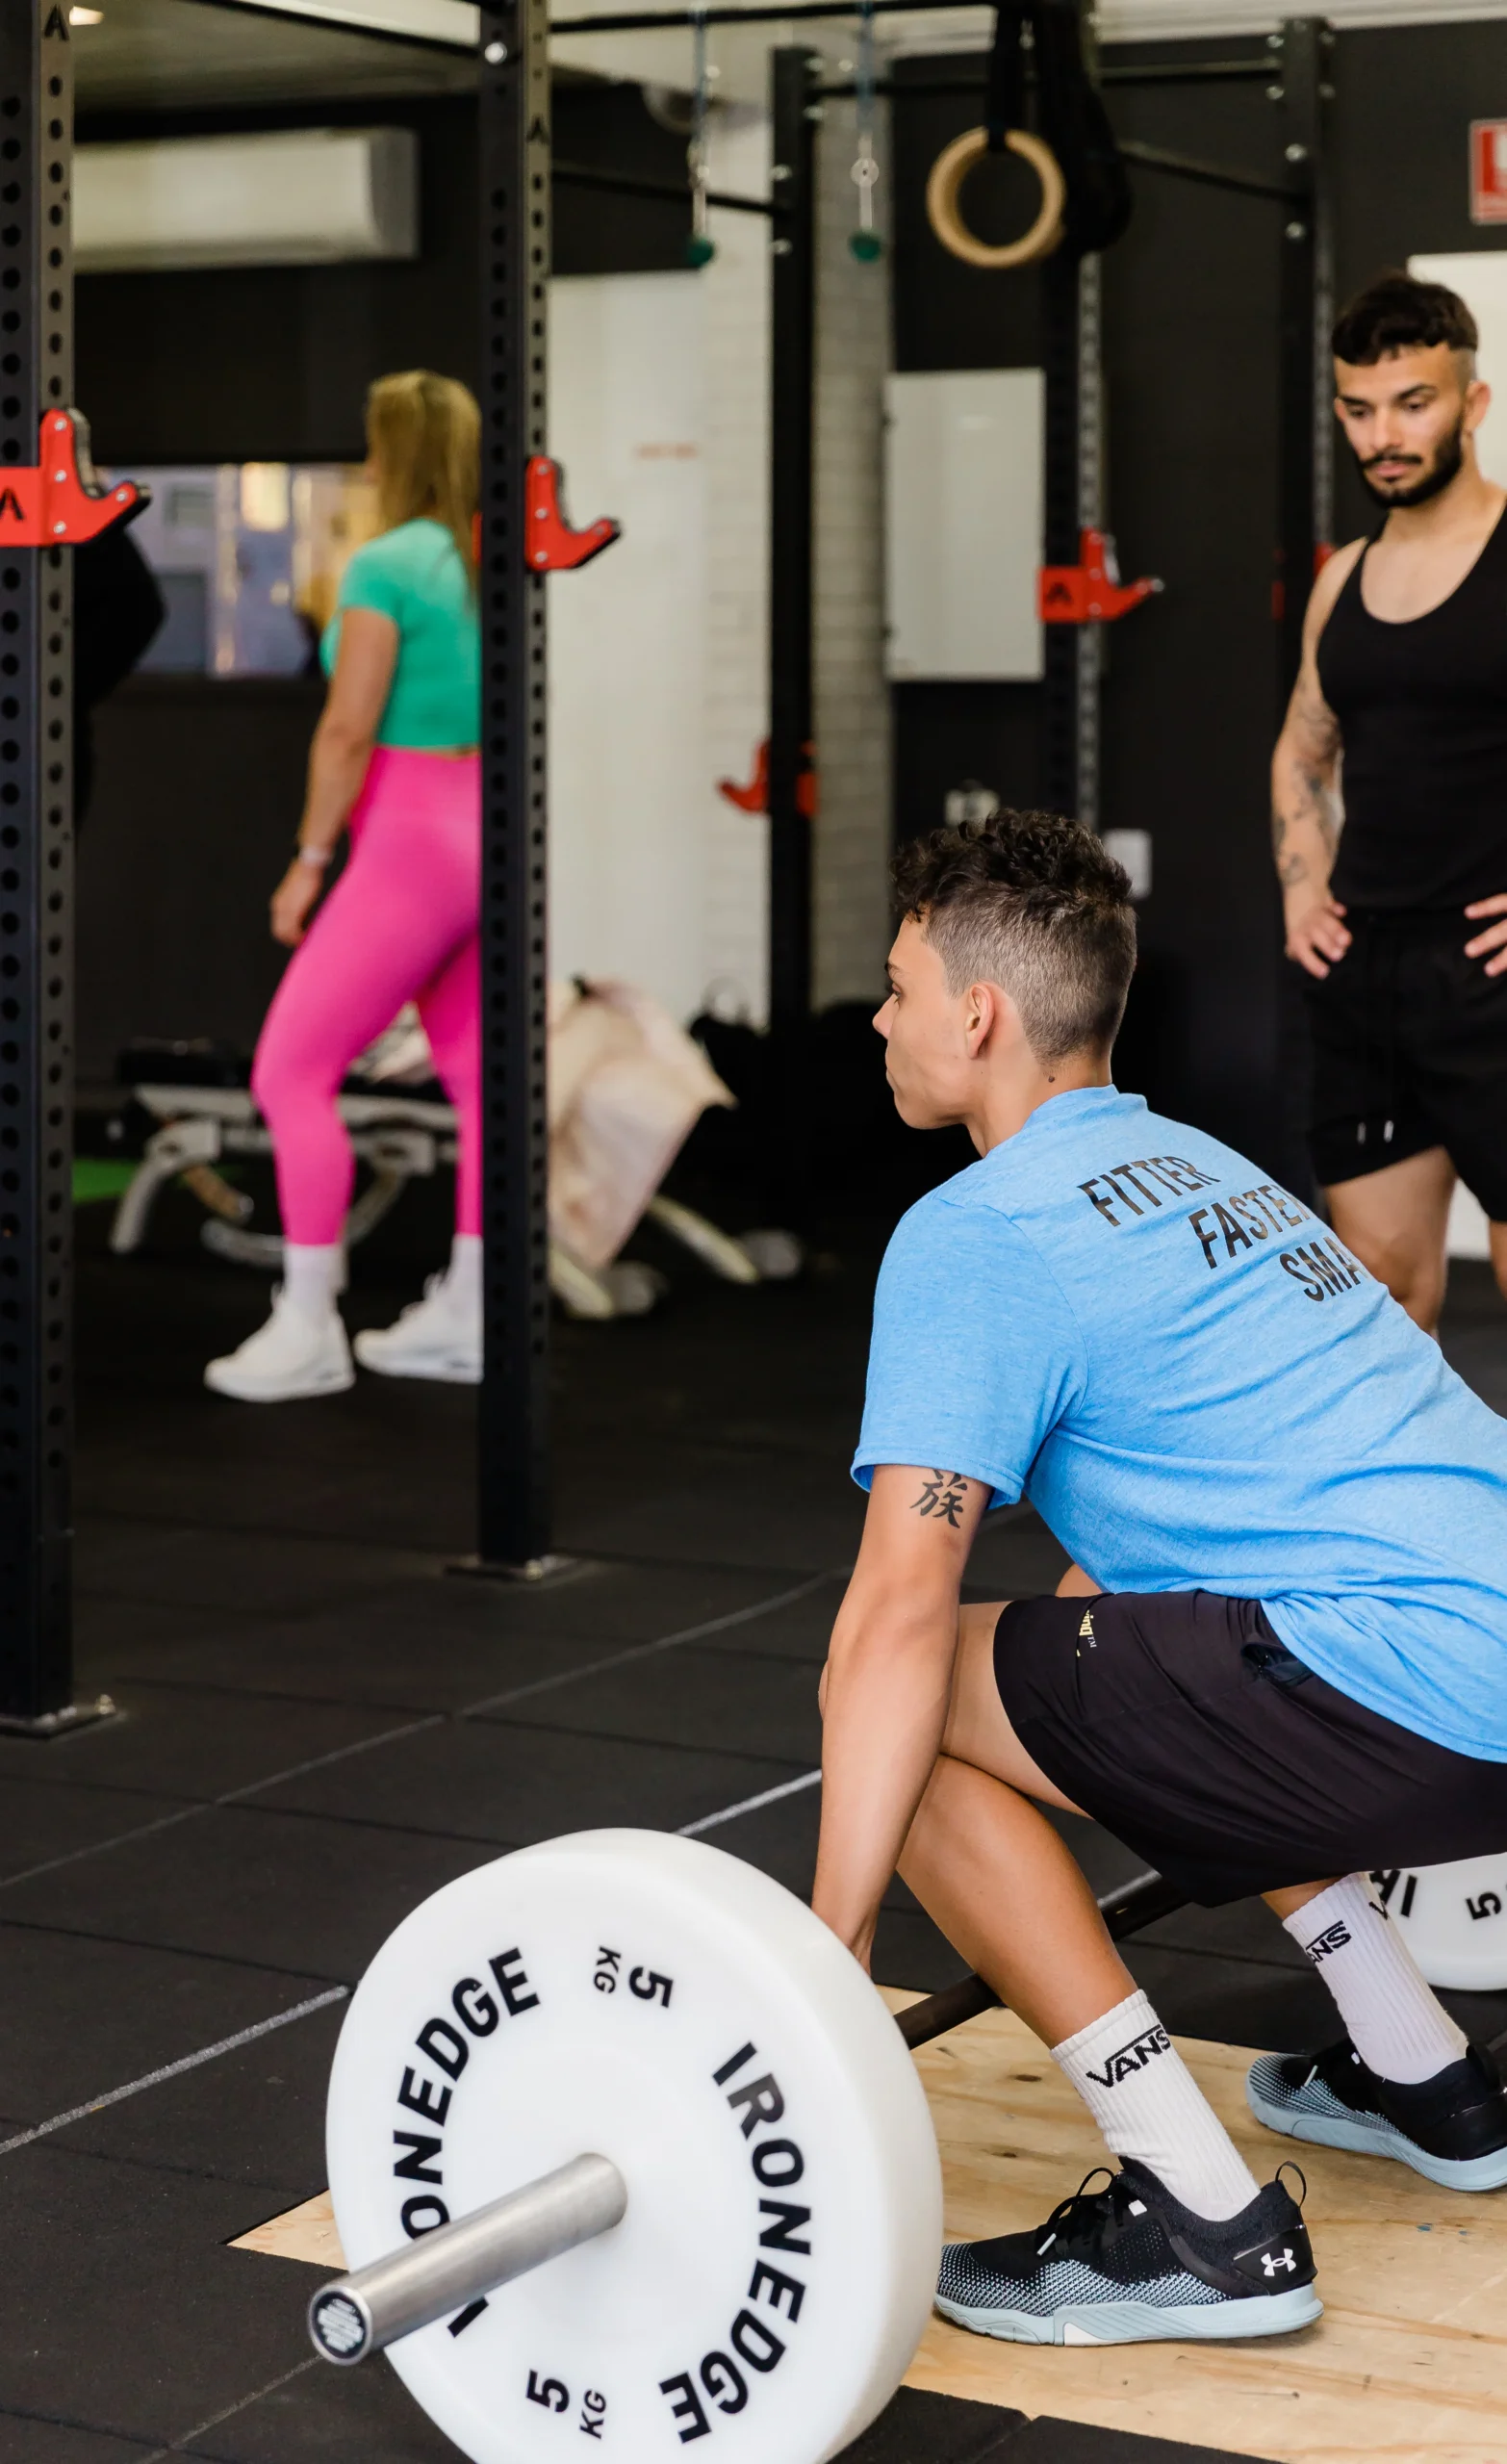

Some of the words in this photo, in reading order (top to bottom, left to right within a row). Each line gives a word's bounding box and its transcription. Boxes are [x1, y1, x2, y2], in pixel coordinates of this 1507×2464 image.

[1077, 1156, 1221, 1227] FITTER
[909, 1469, 968, 1529] 族
[1466, 1891, 1502, 1920] 5
[593, 1945, 623, 1995] KG
[1306, 1919, 1352, 1964] ANS
[628, 1964, 674, 2009] 5
[1086, 2023, 1171, 2088] VANS
[393, 1946, 541, 2339] IONEDGE
[658, 2040, 812, 2444] IRONEDGE
[525, 2369, 571, 2414] 5
[578, 2388, 608, 2440] KG
